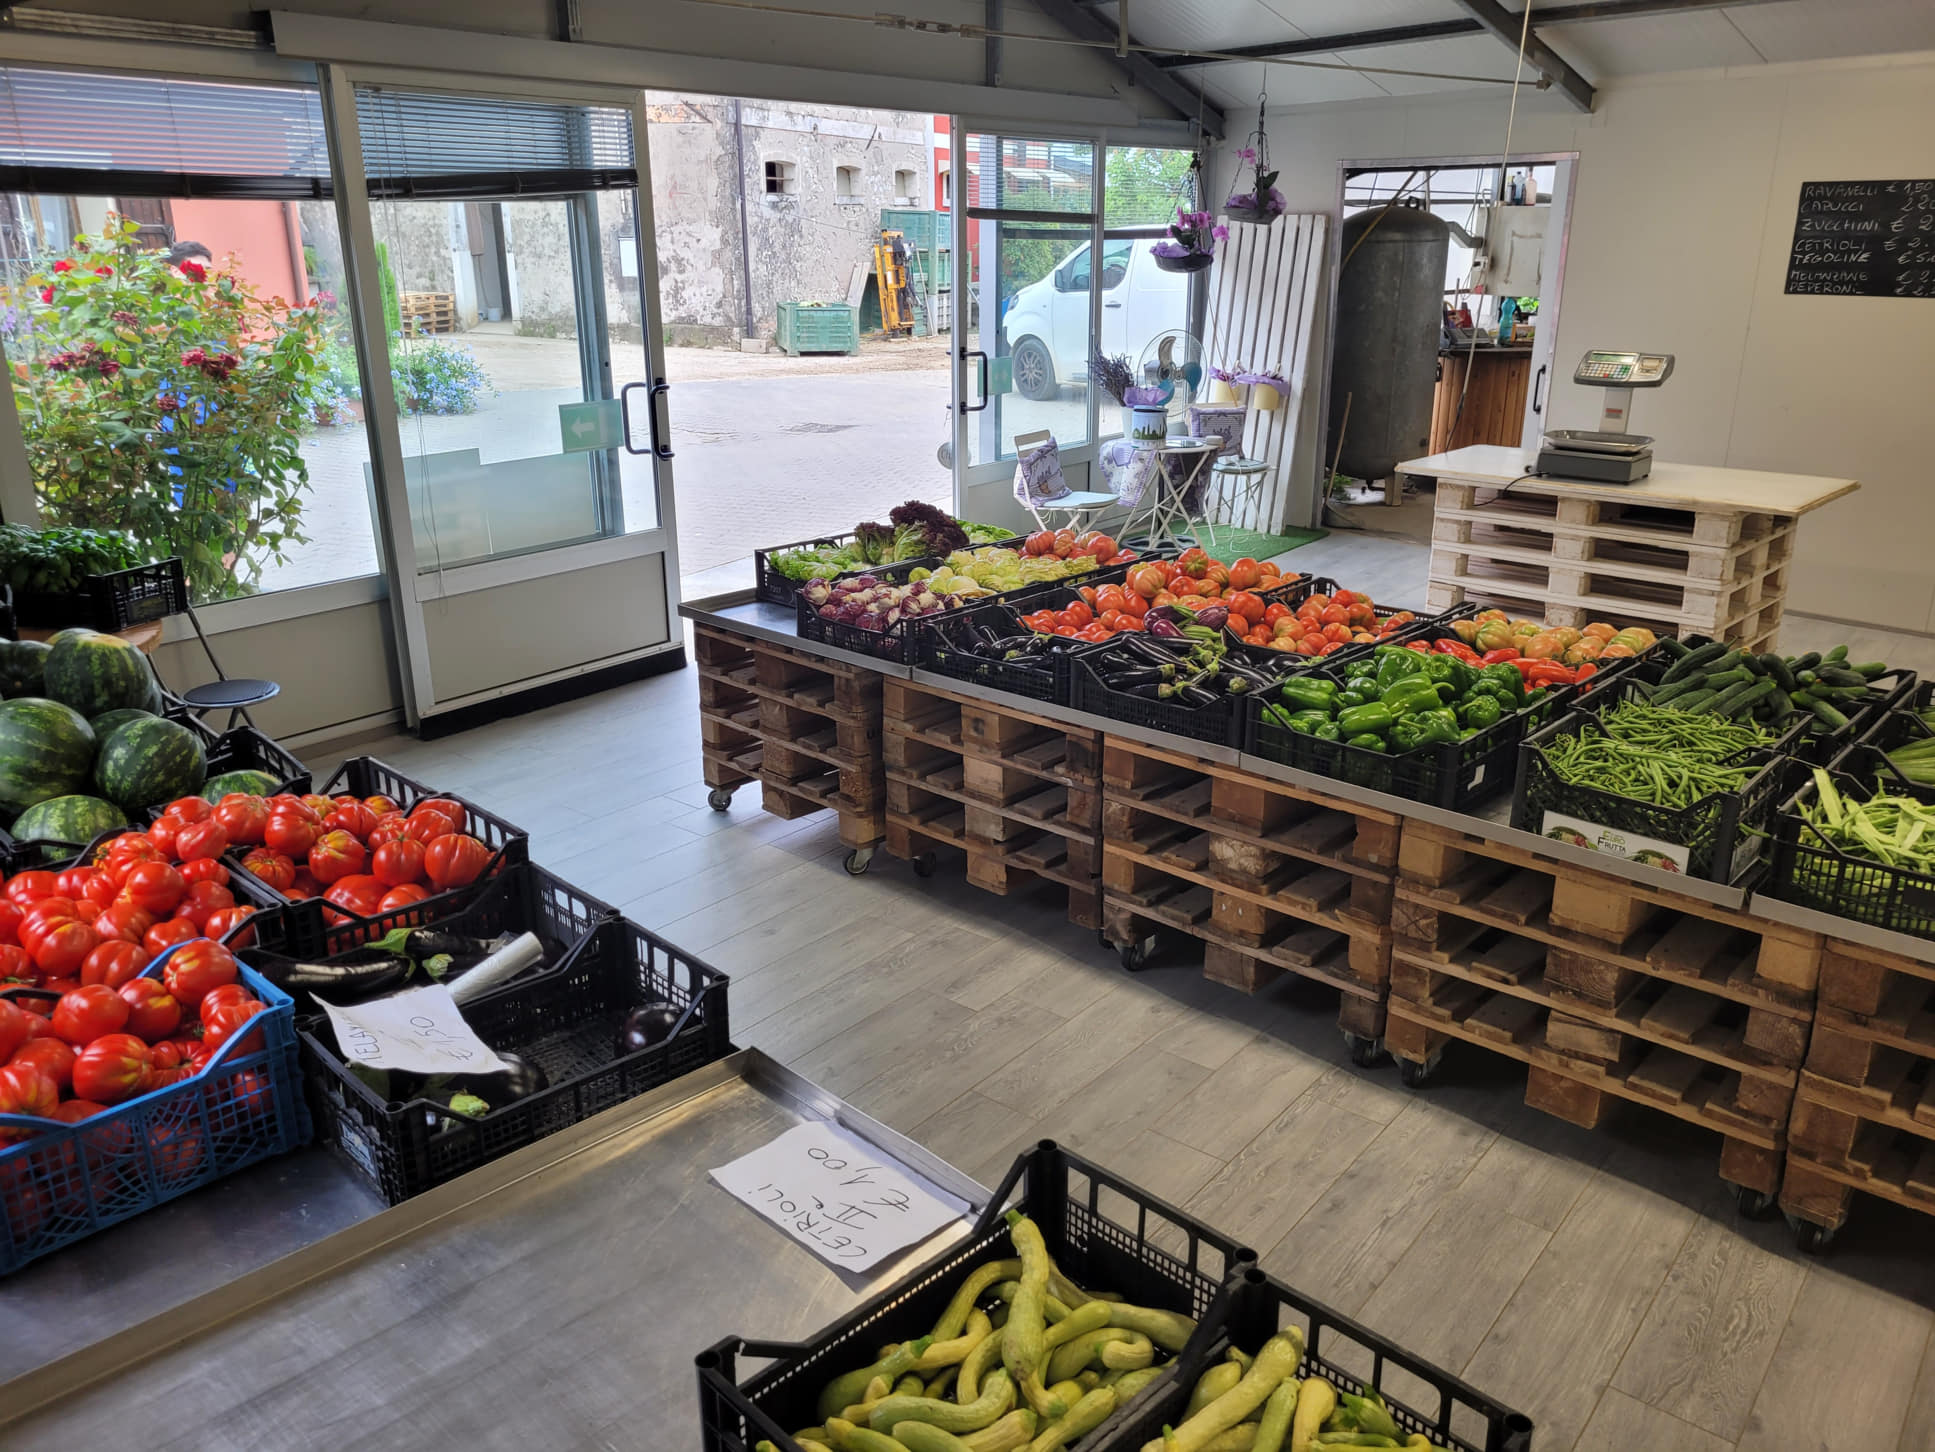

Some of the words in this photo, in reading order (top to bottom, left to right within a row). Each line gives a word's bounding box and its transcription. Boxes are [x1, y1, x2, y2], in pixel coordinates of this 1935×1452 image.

[1805, 184, 1878, 197] RAVANELLI
[1800, 201, 1863, 213] CAPUCCI
[1890, 215, 1909, 232] €
[1795, 239, 1866, 252] CETRIOLI
[1883, 236, 1899, 251] €
[1793, 251, 1872, 265] TEGOLINE
[1597, 836, 1626, 852] FRUTTA
[808, 1148, 883, 1186] 1,00
[748, 1183, 867, 1257] CETRIOLI
